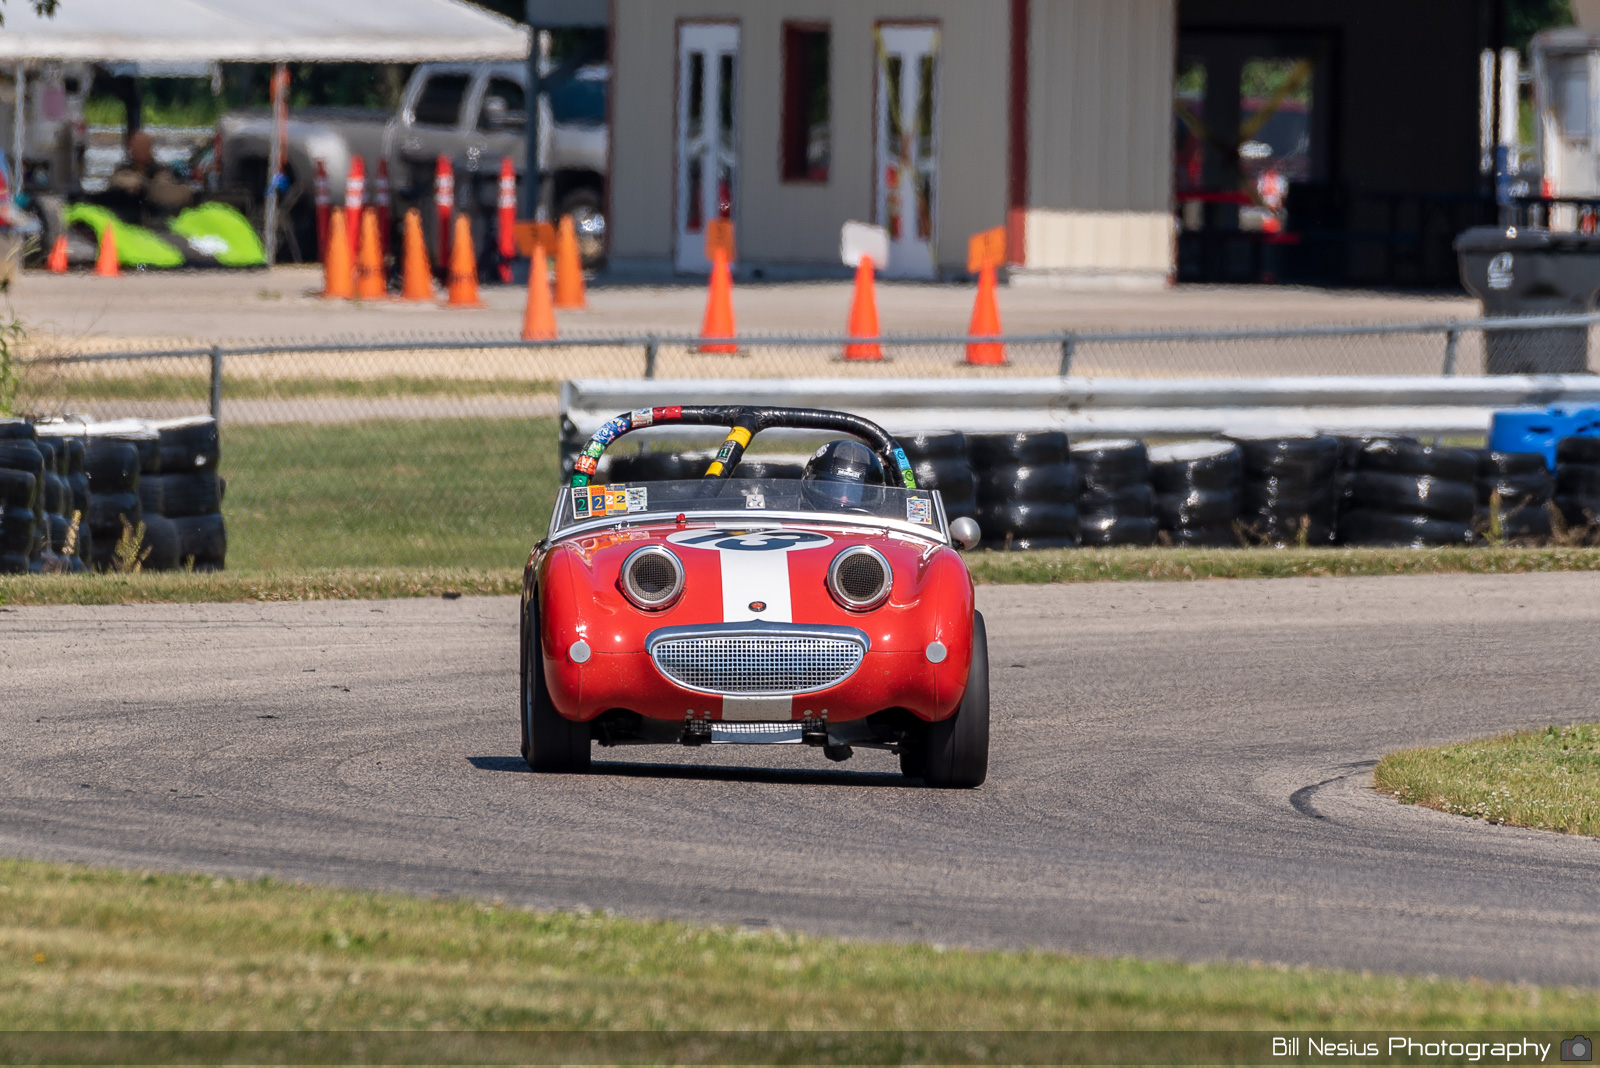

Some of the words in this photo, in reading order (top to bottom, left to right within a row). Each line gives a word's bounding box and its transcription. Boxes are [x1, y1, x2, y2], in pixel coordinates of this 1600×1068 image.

[577, 498, 586, 511] 2
[594, 496, 603, 509] 2
[606, 494, 614, 505] 2
[616, 494, 626, 503] 2
[675, 528, 829, 551] 73
